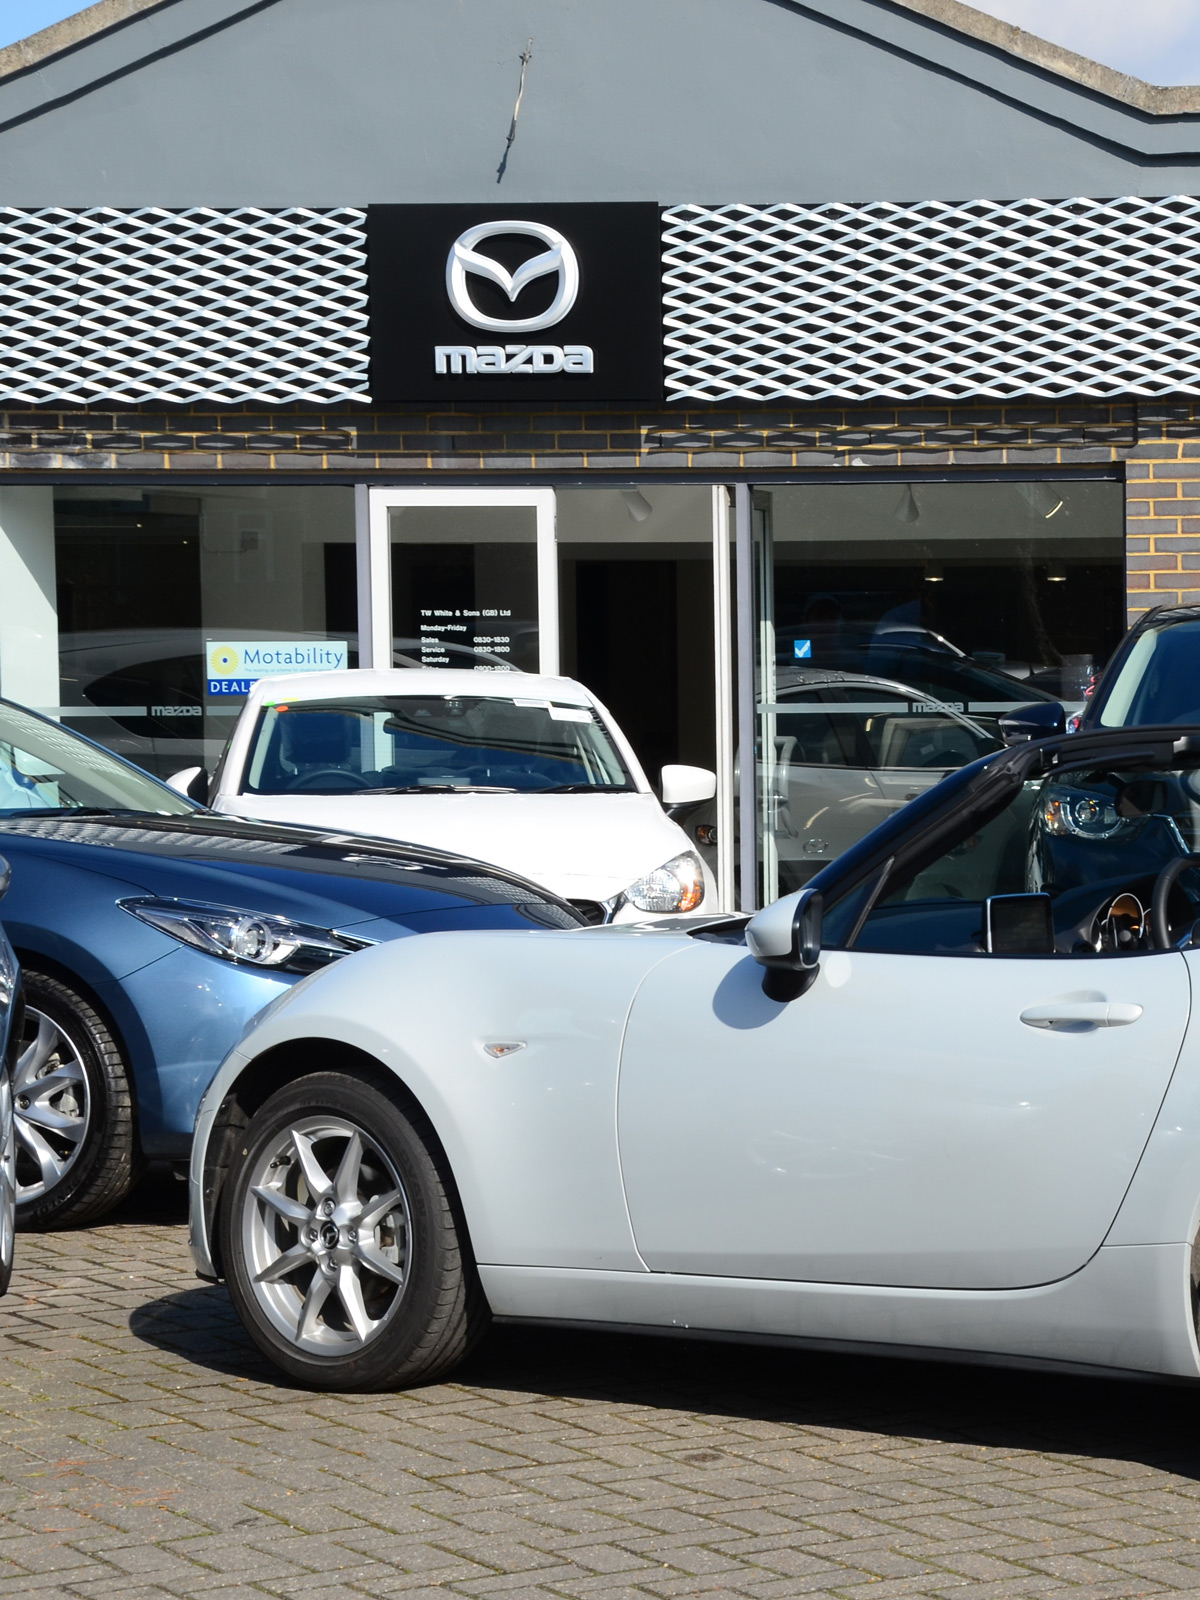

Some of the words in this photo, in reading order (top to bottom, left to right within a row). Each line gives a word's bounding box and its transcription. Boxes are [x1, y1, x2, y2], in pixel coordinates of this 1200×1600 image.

[482, 609, 498, 617] (GB)
[420, 624, 467, 632] Monday-Friday
[244, 648, 343, 668] Motability
